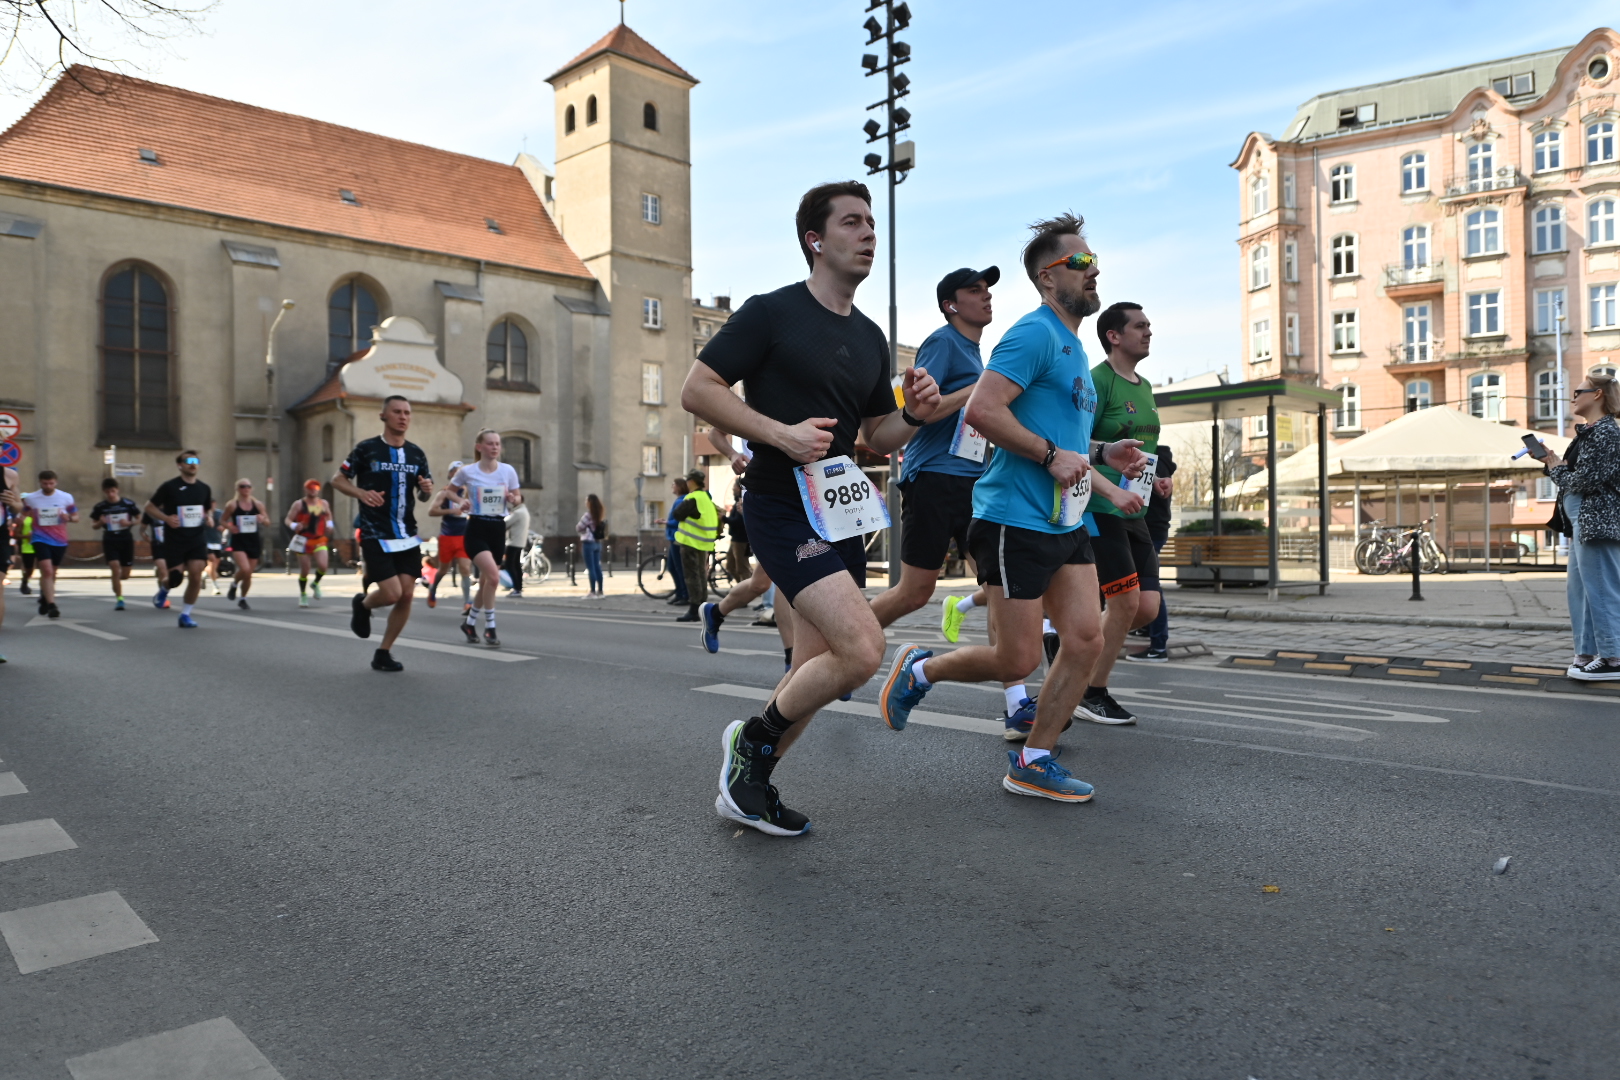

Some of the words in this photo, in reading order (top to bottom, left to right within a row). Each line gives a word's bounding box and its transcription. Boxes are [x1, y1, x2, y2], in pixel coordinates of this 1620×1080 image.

[824, 480, 870, 508] 9889
[844, 505, 864, 515] Patryk
[901, 650, 918, 671] HOKA
